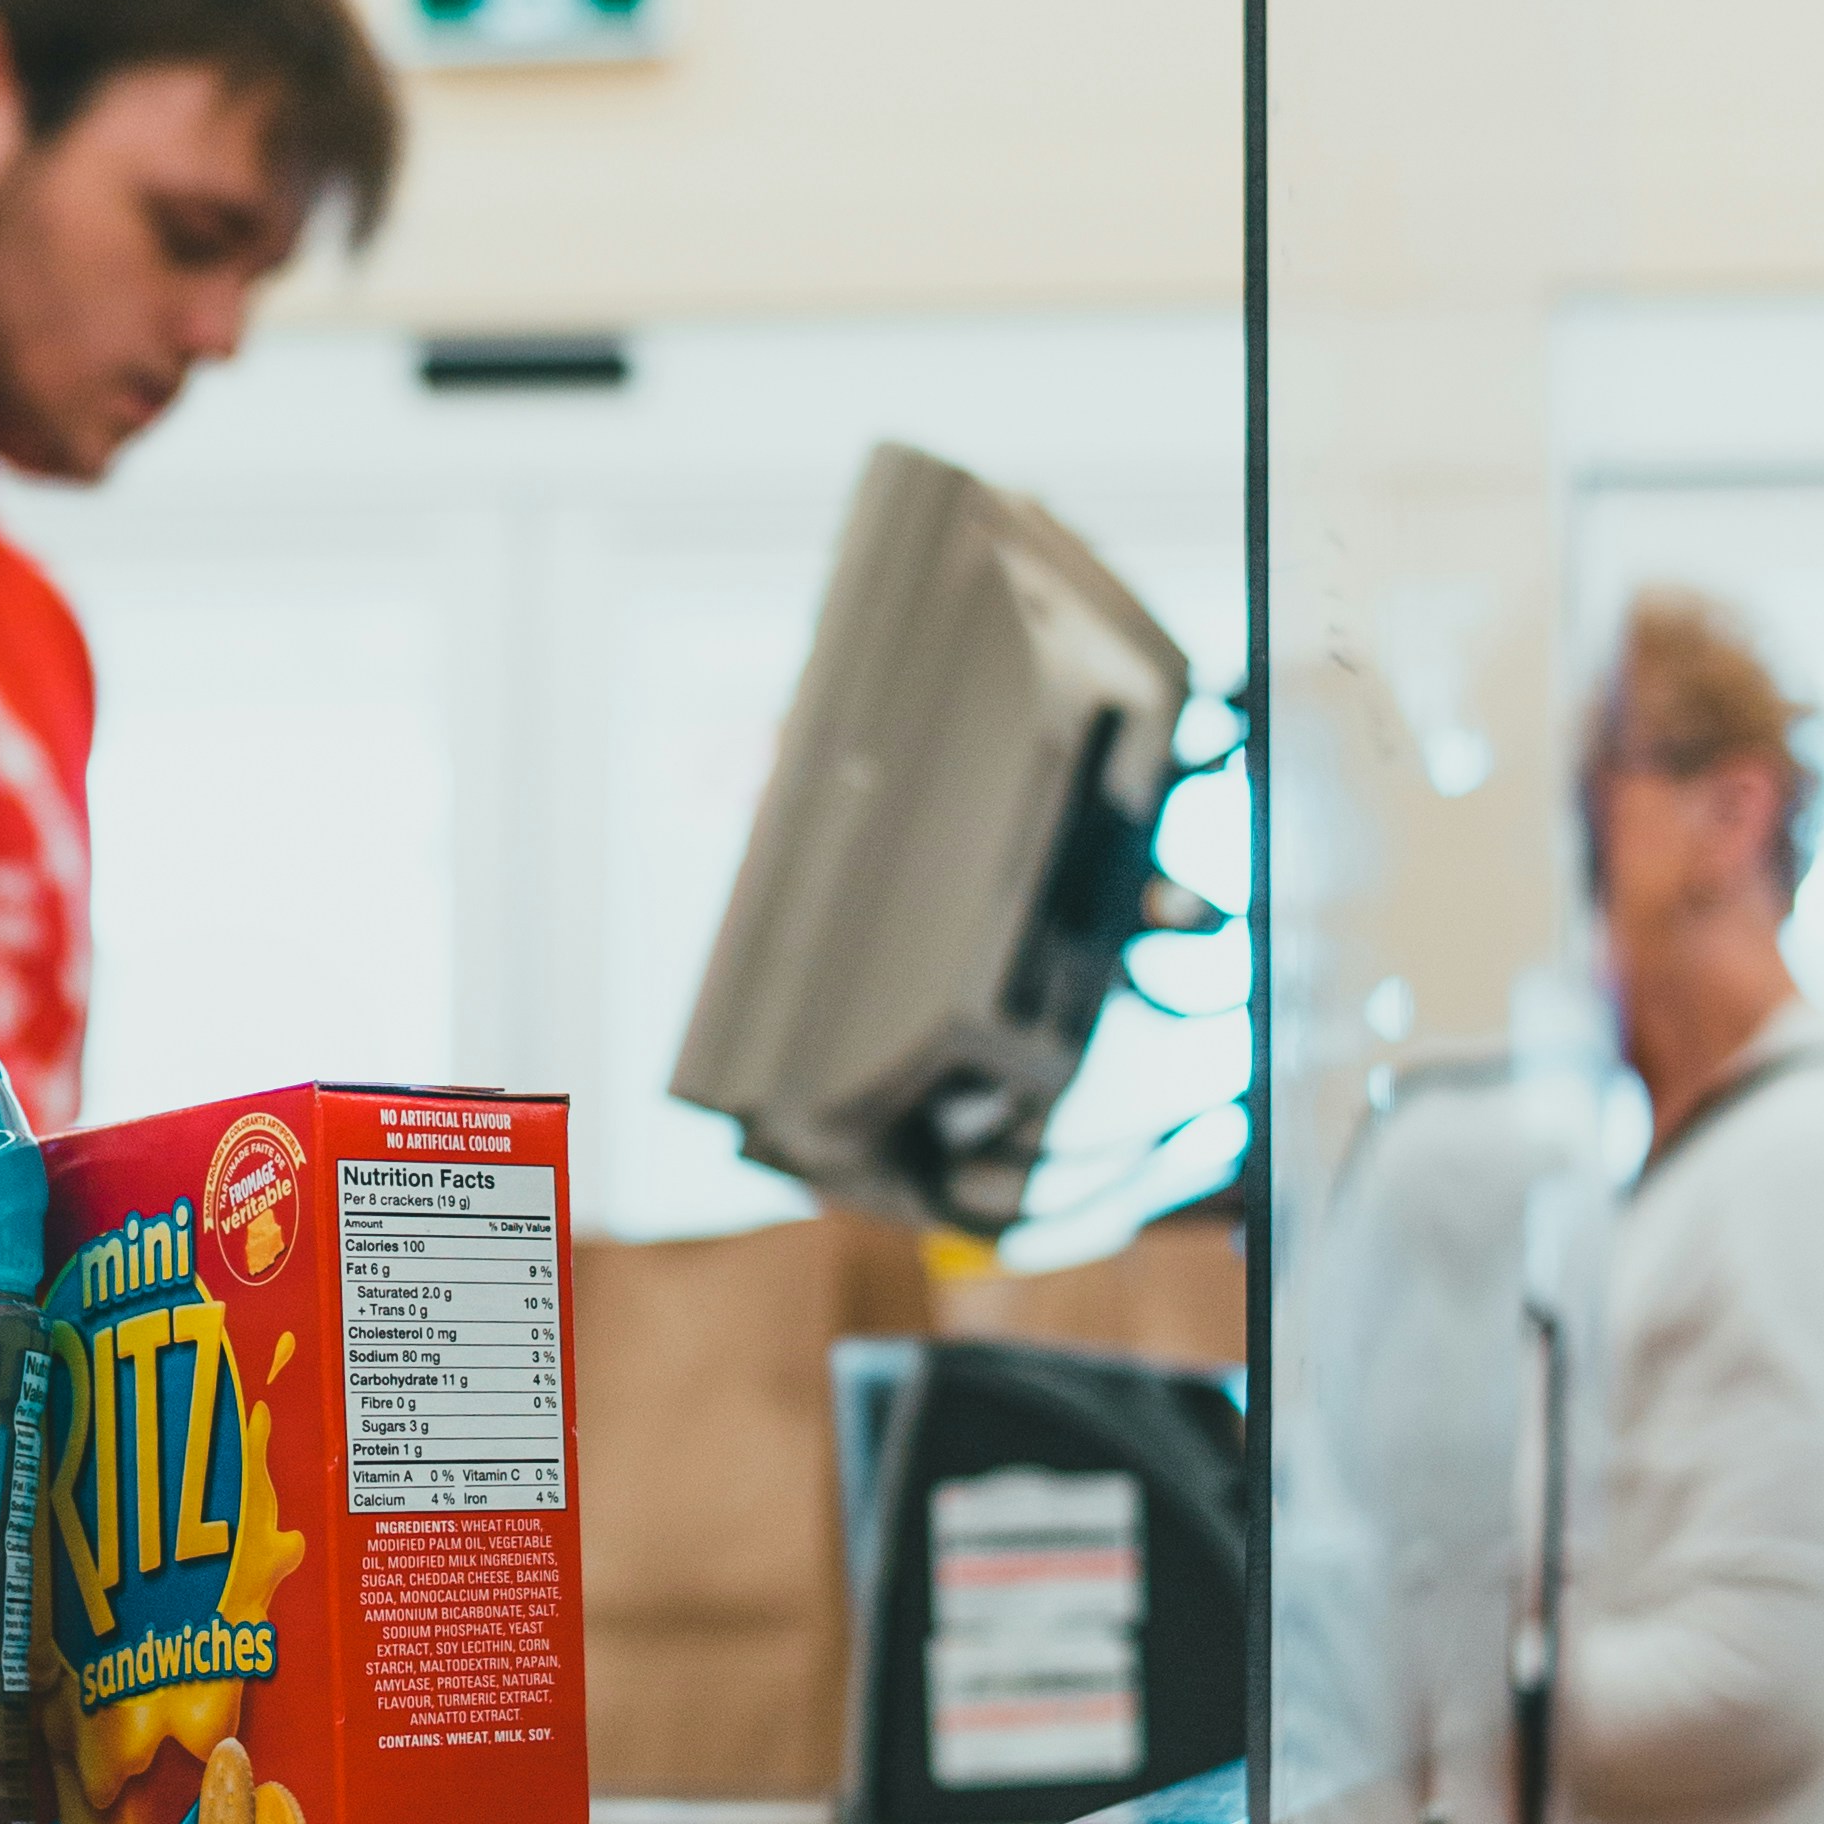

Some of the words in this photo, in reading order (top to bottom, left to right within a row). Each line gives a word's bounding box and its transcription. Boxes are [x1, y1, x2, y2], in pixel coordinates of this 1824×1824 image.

[380, 1109, 397, 1125] NO
[401, 1110, 460, 1128] ARTIFICIAL
[463, 1113, 511, 1130] FLAVOUR
[387, 1132, 403, 1148] NO
[407, 1133, 466, 1151] ARTIFICIAL
[469, 1136, 511, 1152] COLOUR
[251, 1143, 274, 1158] FAITE
[274, 1153, 286, 1171] DE
[229, 1160, 276, 1207] FROMAGE
[344, 1166, 433, 1187] Nutrition
[441, 1169, 495, 1189] Facts
[221, 1178, 292, 1235] véritable
[344, 1192, 365, 1206] Per
[369, 1193, 376, 1205] 8
[381, 1194, 433, 1207] crackers
[437, 1195, 456, 1209] (19
[459, 1197, 470, 1210] g)
[345, 1219, 383, 1228] Amount
[489, 1222, 497, 1230] %
[501, 1223, 523, 1233] Daily
[526, 1223, 551, 1232] Value
[346, 1240, 399, 1252] Calories
[403, 1241, 425, 1252] 100
[82, 1205, 189, 1309] mini
[376, 1521, 458, 1534] INGREDIENTS:
[461, 1520, 503, 1533] WHEAT
[505, 1519, 543, 1532] FLOUR,
[368, 1538, 425, 1551] MODIFIED
[429, 1537, 461, 1550] PALM
[465, 1537, 486, 1550] OIL,
[489, 1536, 552, 1549] VEGETABLE
[362, 1556, 384, 1570] OIL,
[388, 1555, 445, 1569] MODIFIED
[449, 1554, 476, 1567] MILK
[480, 1553, 558, 1567] INGREDIENTS,
[361, 1574, 406, 1588] SUGAR,
[409, 1573, 464, 1586] CHEDDAR
[468, 1571, 513, 1585] CHEESE,
[517, 1570, 559, 1582] BAKING
[360, 1592, 396, 1605] SODA,
[400, 1590, 489, 1604] MONOCALCIUM
[493, 1587, 562, 1601] PHOSPHATE,
[365, 1608, 437, 1622] AMMONIUM
[441, 1606, 525, 1620] BICARBONATE,
[528, 1604, 559, 1617] SALT,
[82, 1618, 273, 1706] sandwiches
[379, 1734, 443, 1749] CONTAINS:
[446, 1732, 491, 1745] WHEAT,
[495, 1730, 525, 1743] MILK,
[529, 1728, 554, 1741] SOY.
